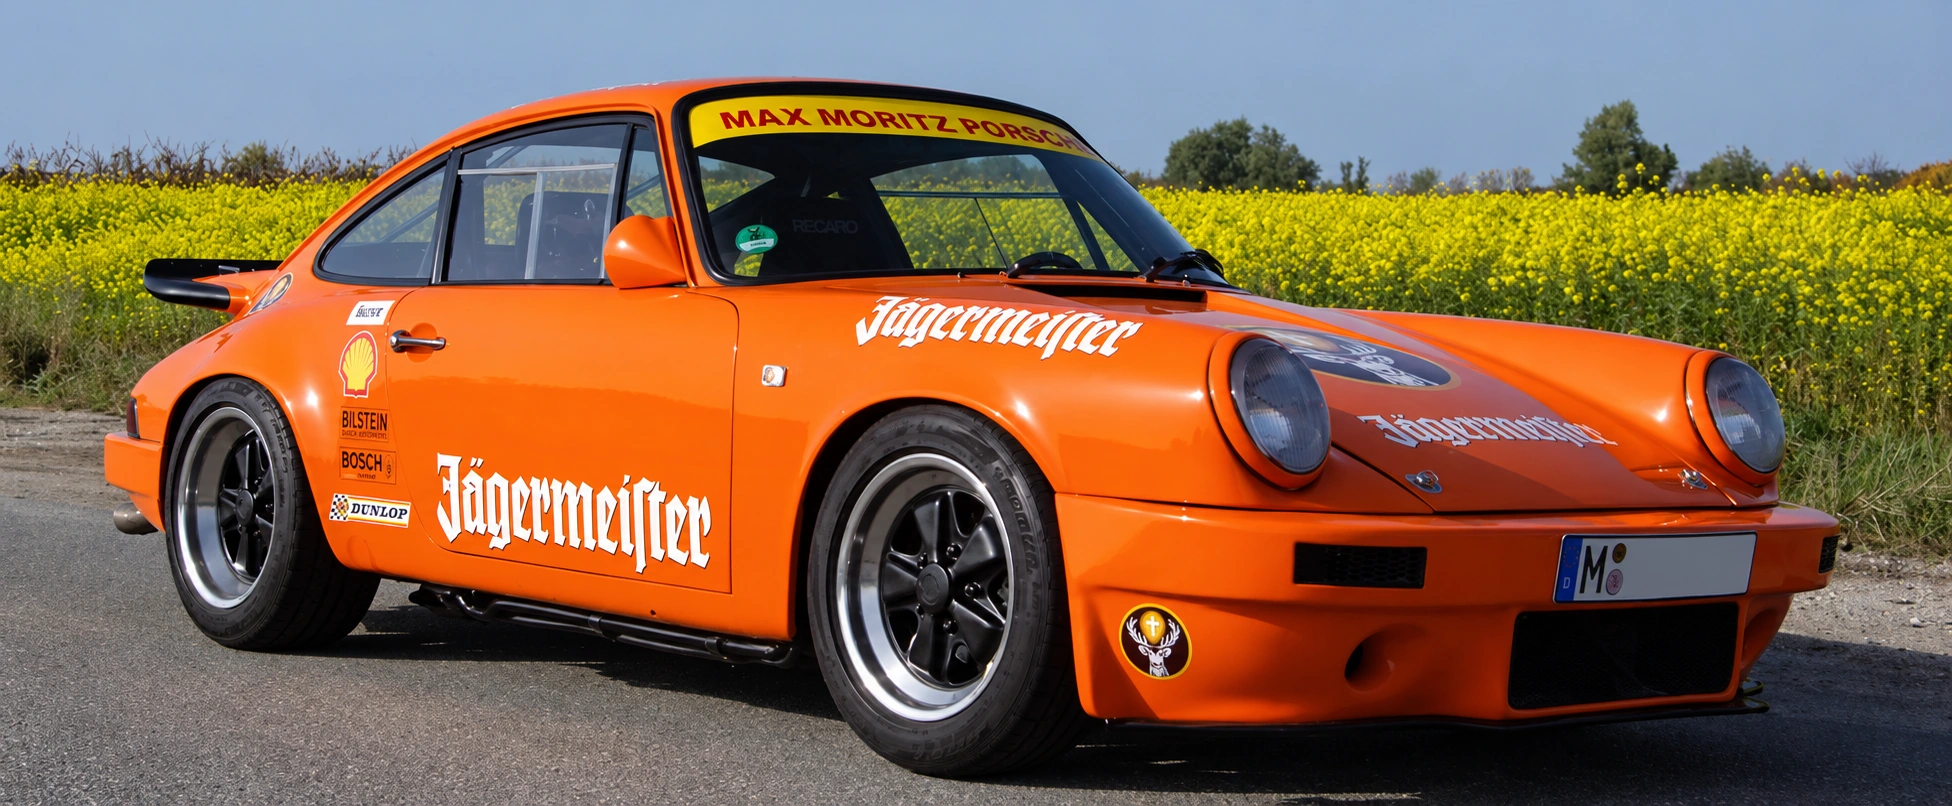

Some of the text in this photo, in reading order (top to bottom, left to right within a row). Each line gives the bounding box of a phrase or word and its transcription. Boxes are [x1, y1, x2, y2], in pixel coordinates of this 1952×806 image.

[719, 108, 1098, 158] MAX MORITZ PORSCH
[792, 219, 858, 234] RECARO
[342, 410, 388, 431] BILSTEIN
[342, 451, 382, 472] BOSCH
[350, 503, 408, 519] DUNLOP
[1579, 545, 1609, 594] M
[1562, 576, 1571, 589] D
